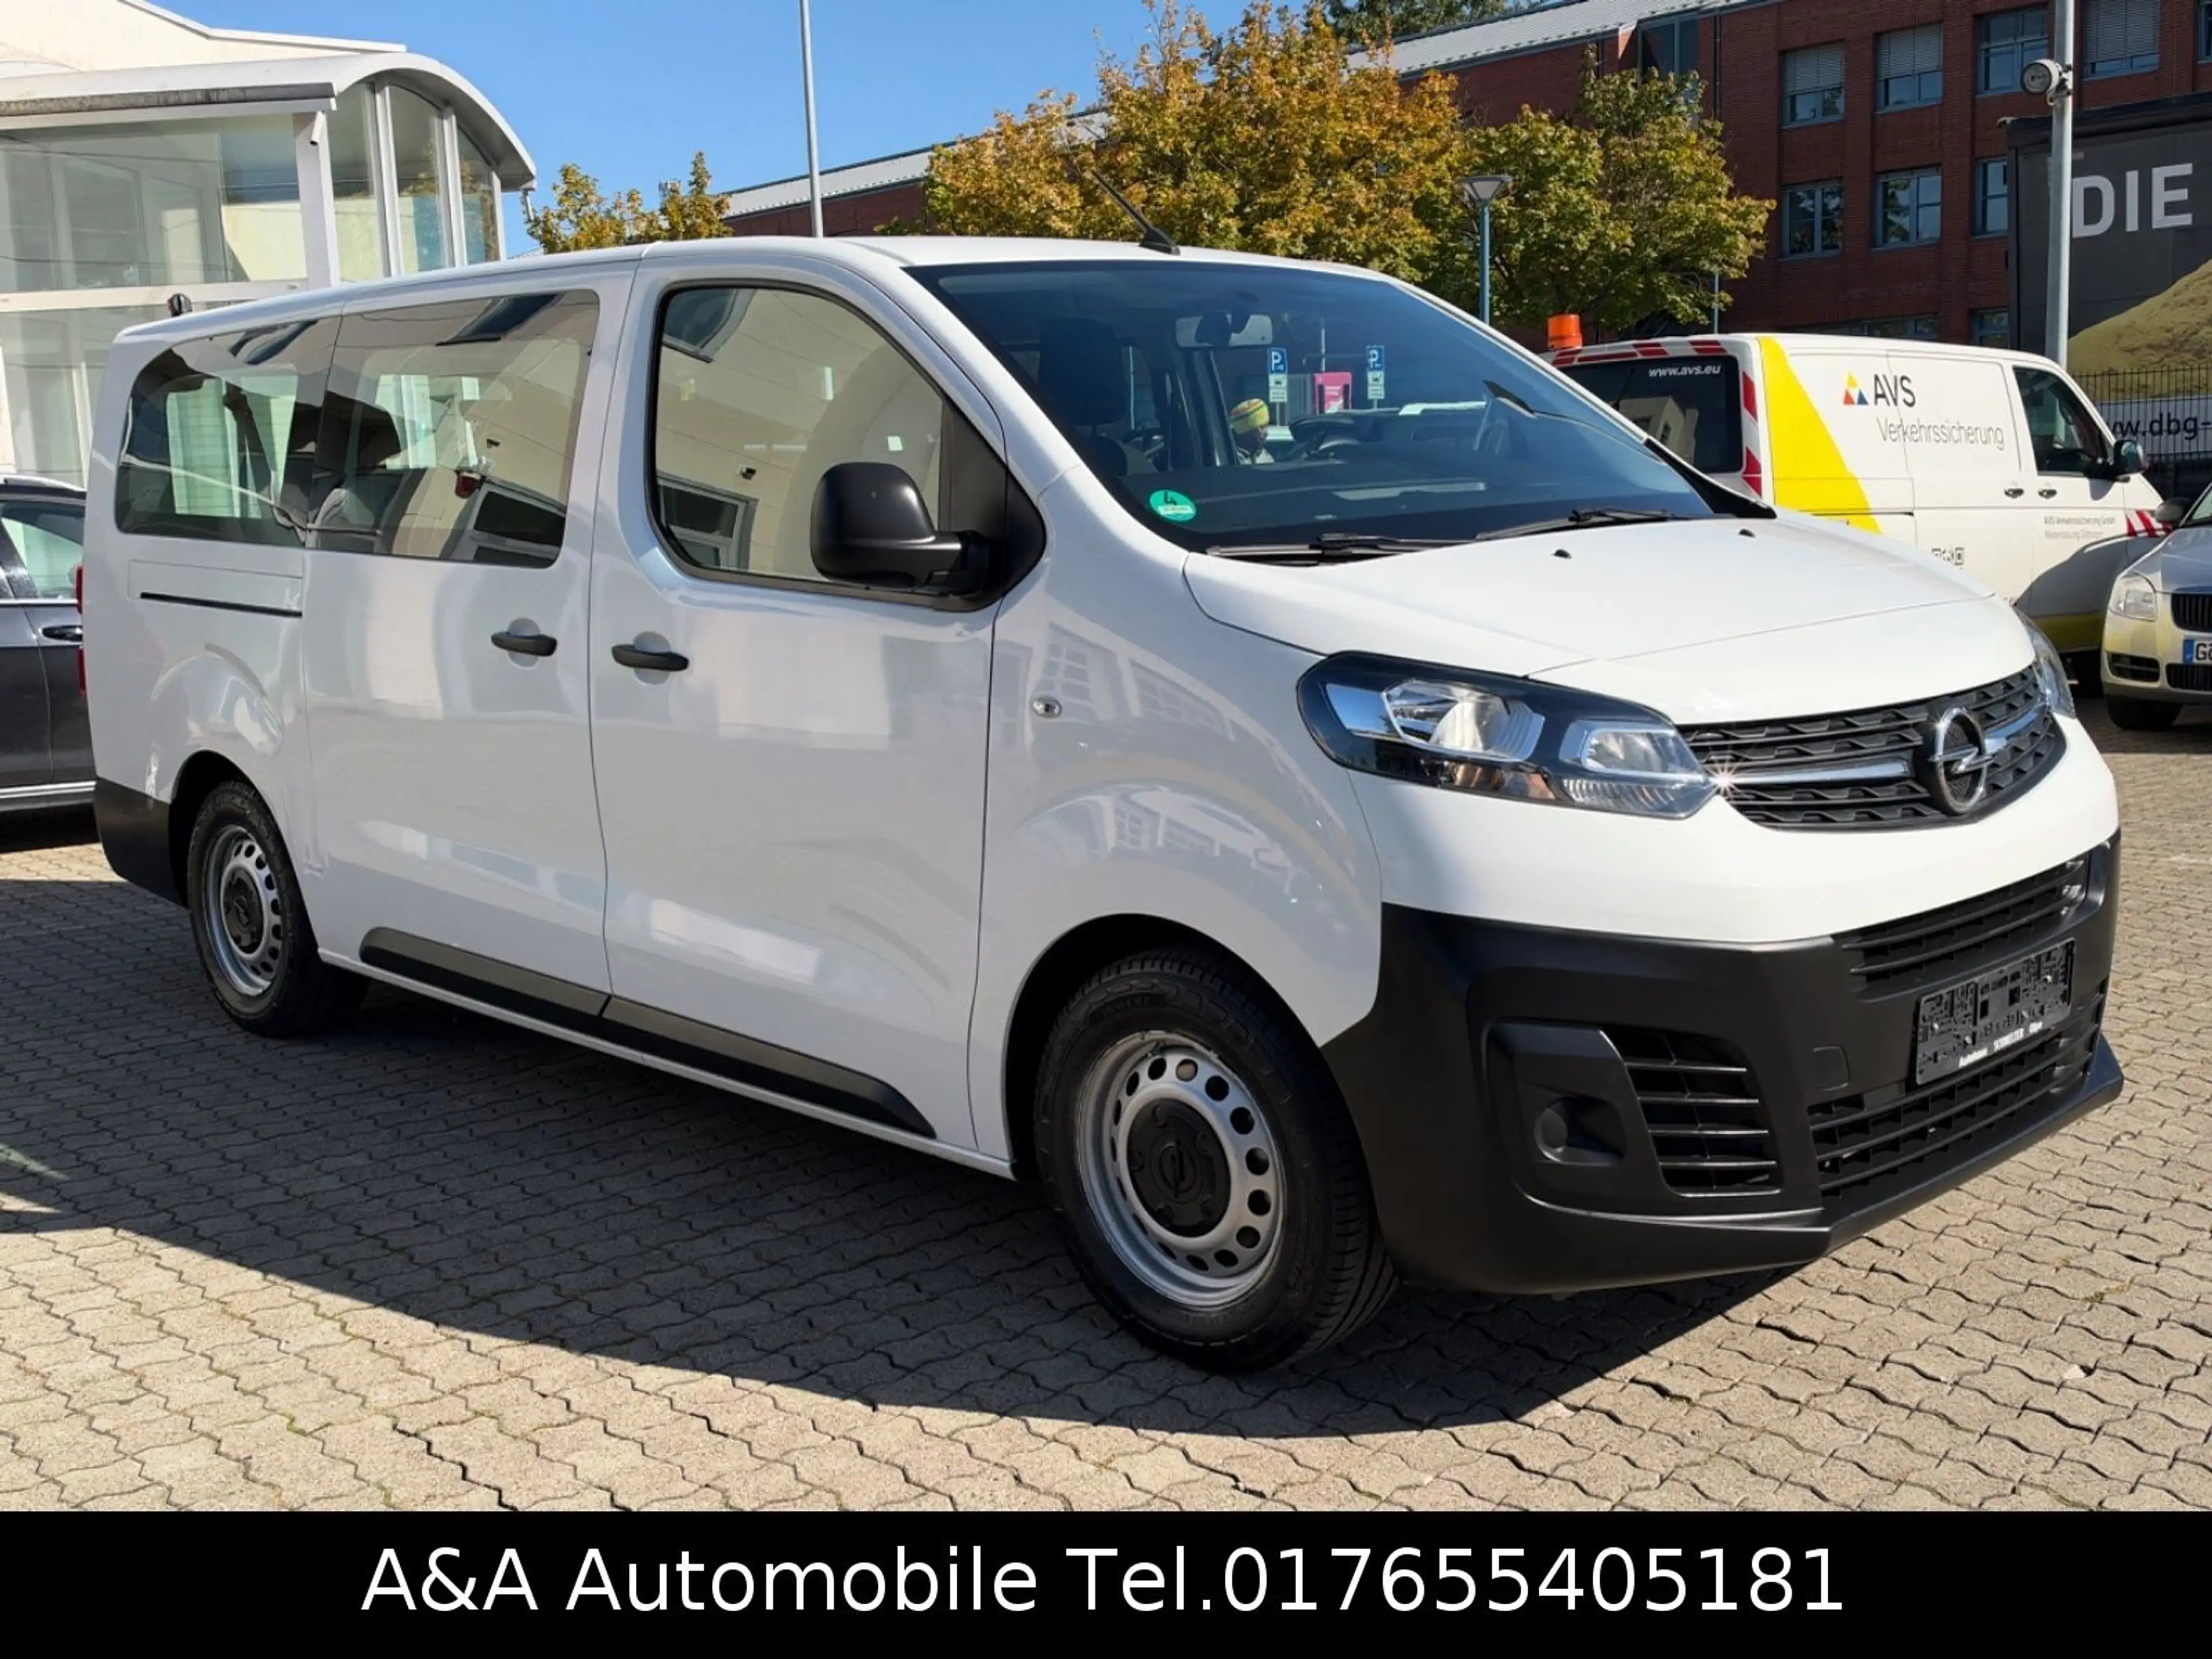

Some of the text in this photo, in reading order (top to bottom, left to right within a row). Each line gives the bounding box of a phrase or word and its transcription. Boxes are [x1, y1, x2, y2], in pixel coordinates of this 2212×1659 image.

[2072, 162, 2193, 238] DIE
[1649, 365, 1721, 377] www.avs.eu
[1874, 374, 1915, 407] AVS
[1876, 417, 2005, 451] Verkehrssicherung
